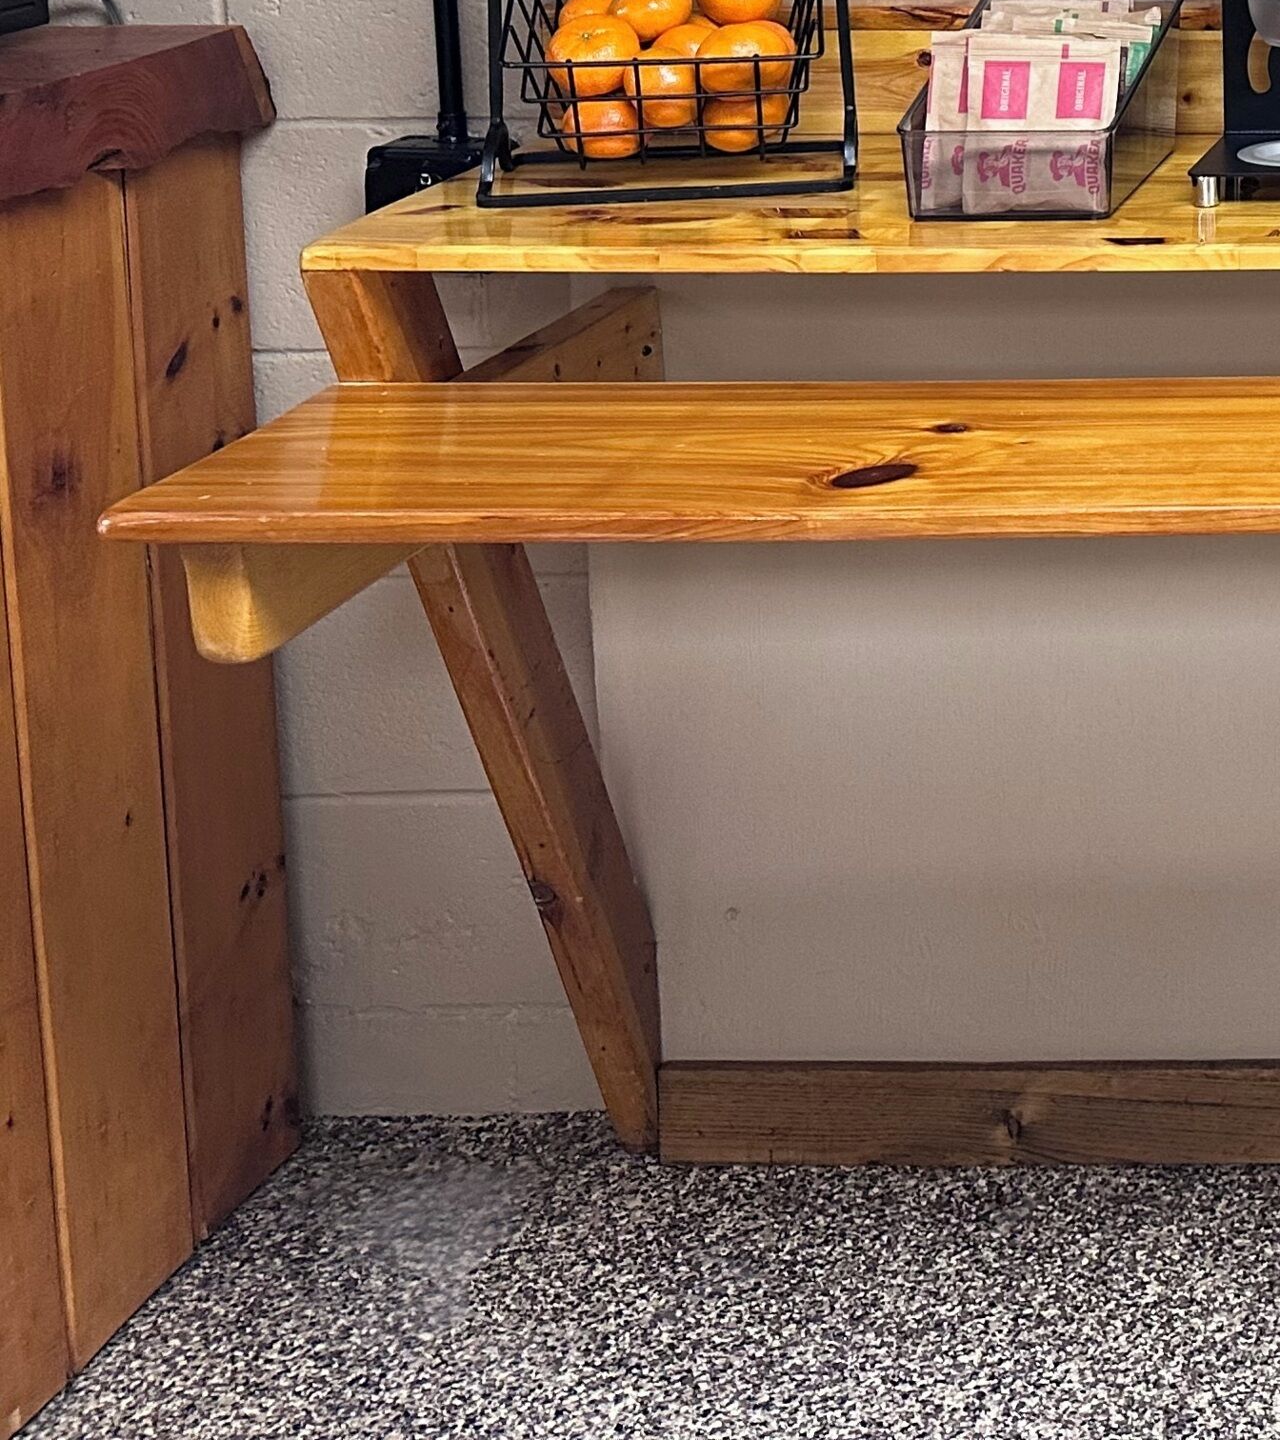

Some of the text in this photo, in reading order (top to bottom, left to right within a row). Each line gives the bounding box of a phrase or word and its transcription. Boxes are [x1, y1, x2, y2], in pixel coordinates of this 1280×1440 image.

[1000, 69, 1012, 112] ORIGINAL
[1074, 71, 1087, 111] ORIGINAL
[1009, 138, 1029, 196] QUAKER
[1084, 139, 1101, 196] QUAKER
